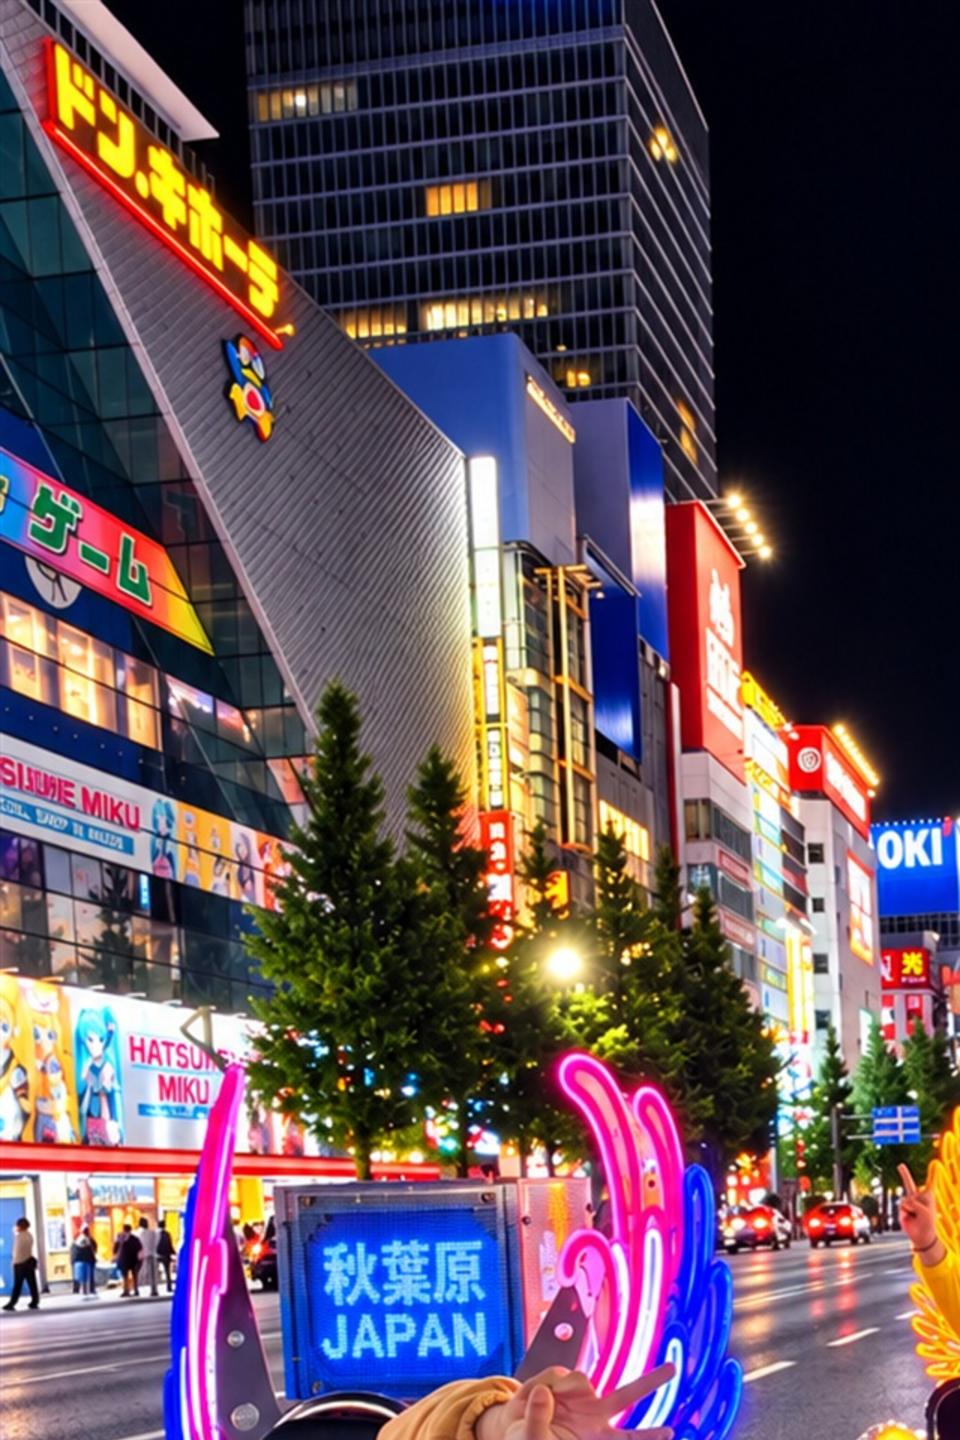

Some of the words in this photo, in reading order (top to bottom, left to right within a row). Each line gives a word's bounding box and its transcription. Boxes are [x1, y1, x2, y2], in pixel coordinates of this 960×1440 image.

[28, 482, 153, 607] ゲーム
[81, 786, 140, 831] MIKU
[868, 827, 943, 870] OKI
[128, 1035, 229, 1072] HATSU
[157, 1073, 209, 1105] MIKU
[322, 1240, 486, 1306] 秋葉原
[321, 1311, 488, 1359] JAPAN
